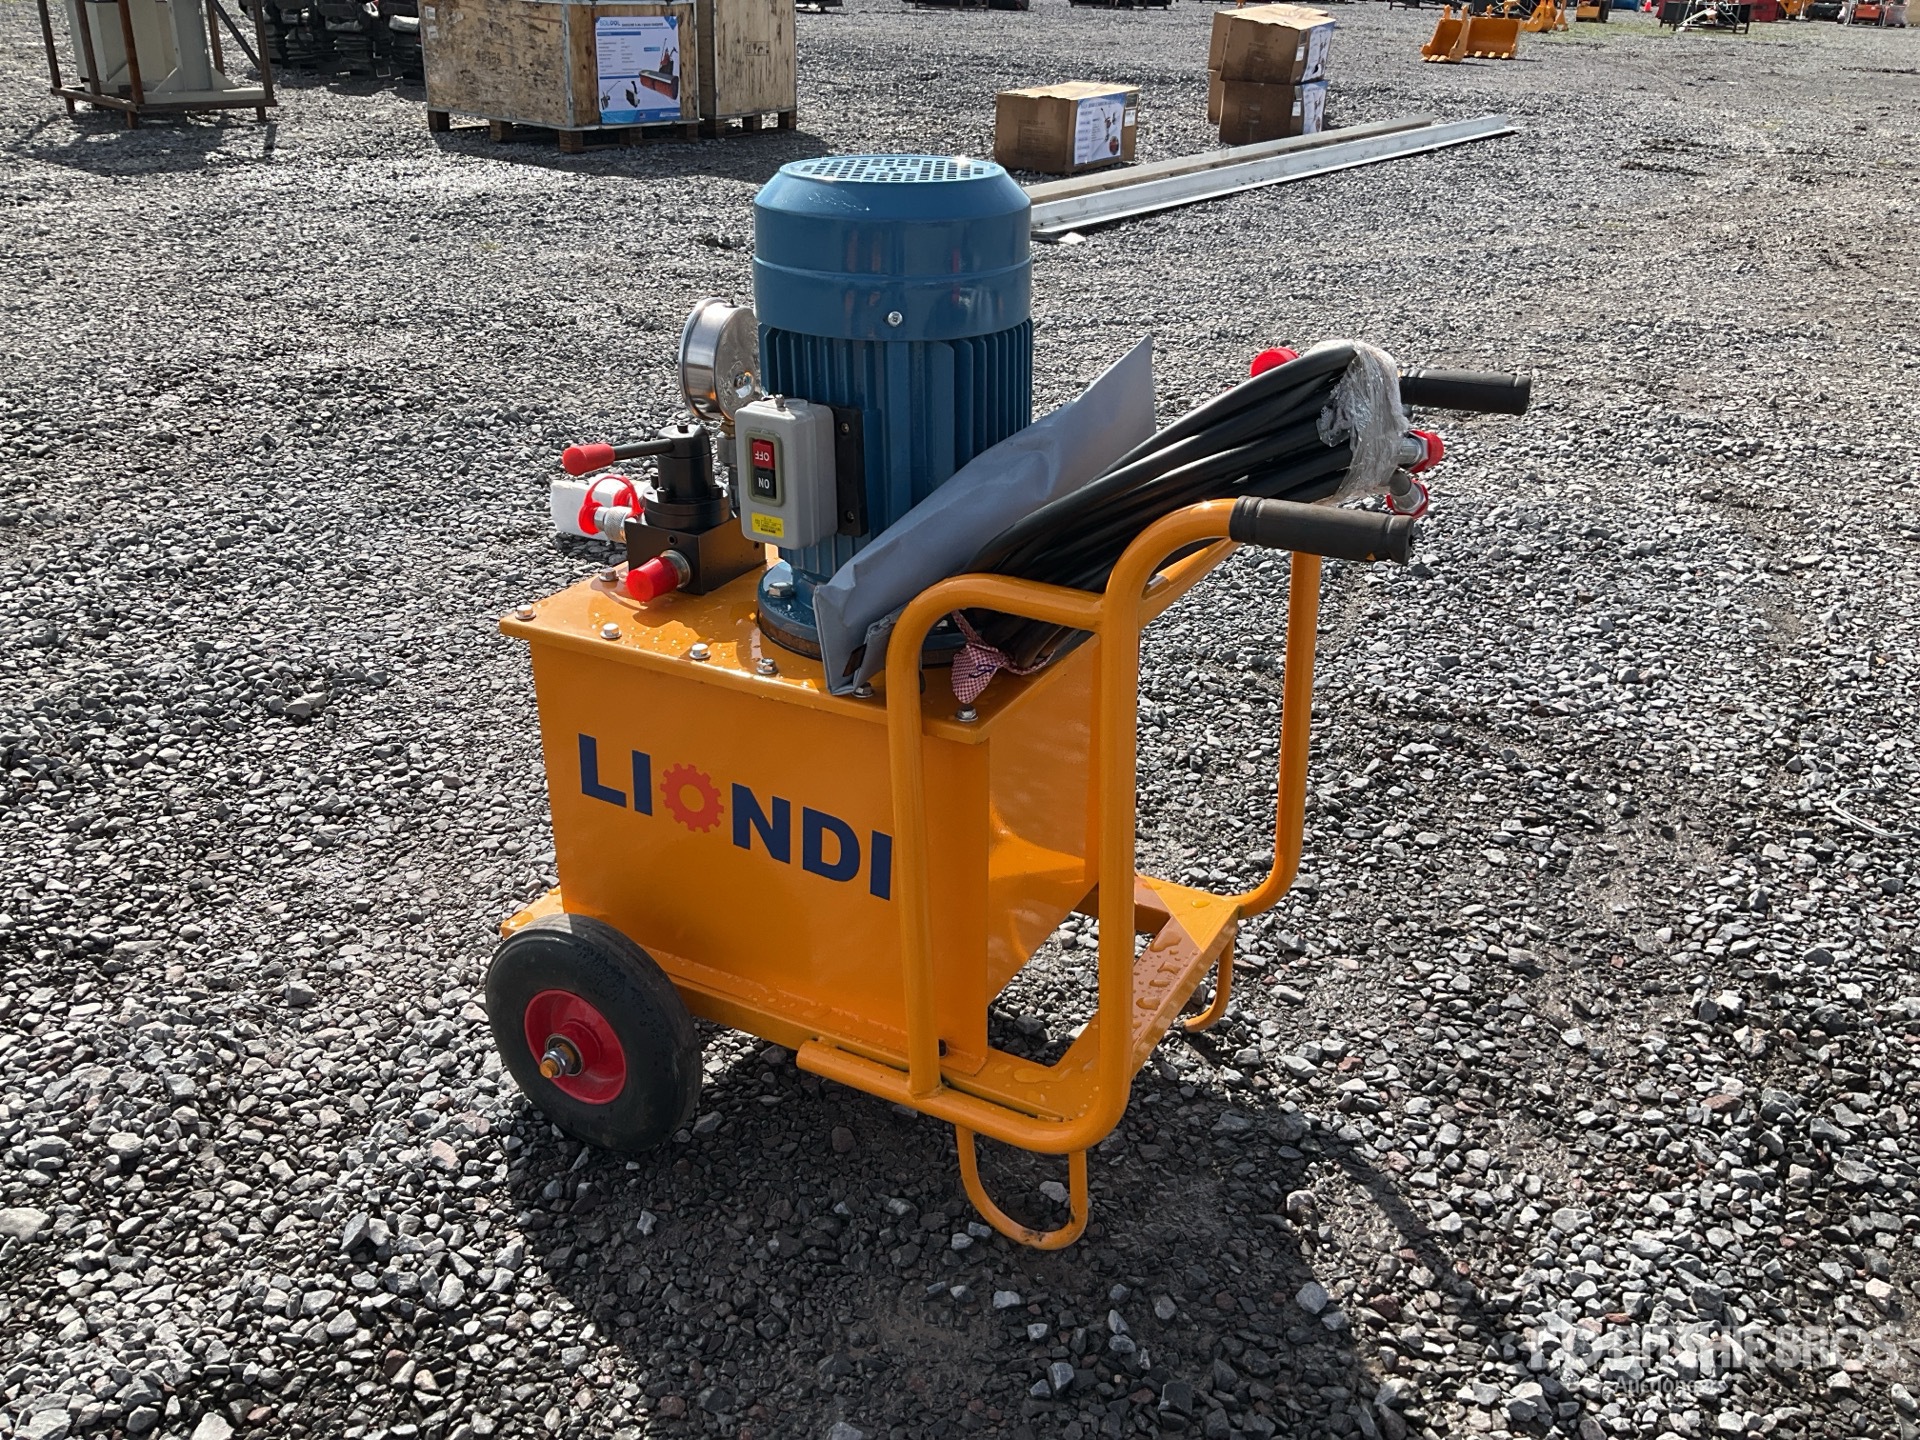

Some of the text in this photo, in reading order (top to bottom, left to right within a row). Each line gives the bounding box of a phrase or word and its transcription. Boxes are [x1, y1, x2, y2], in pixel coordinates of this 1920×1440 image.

[755, 450, 770, 462] OFF
[758, 477, 770, 489] ON
[578, 732, 893, 901] LIONDI
